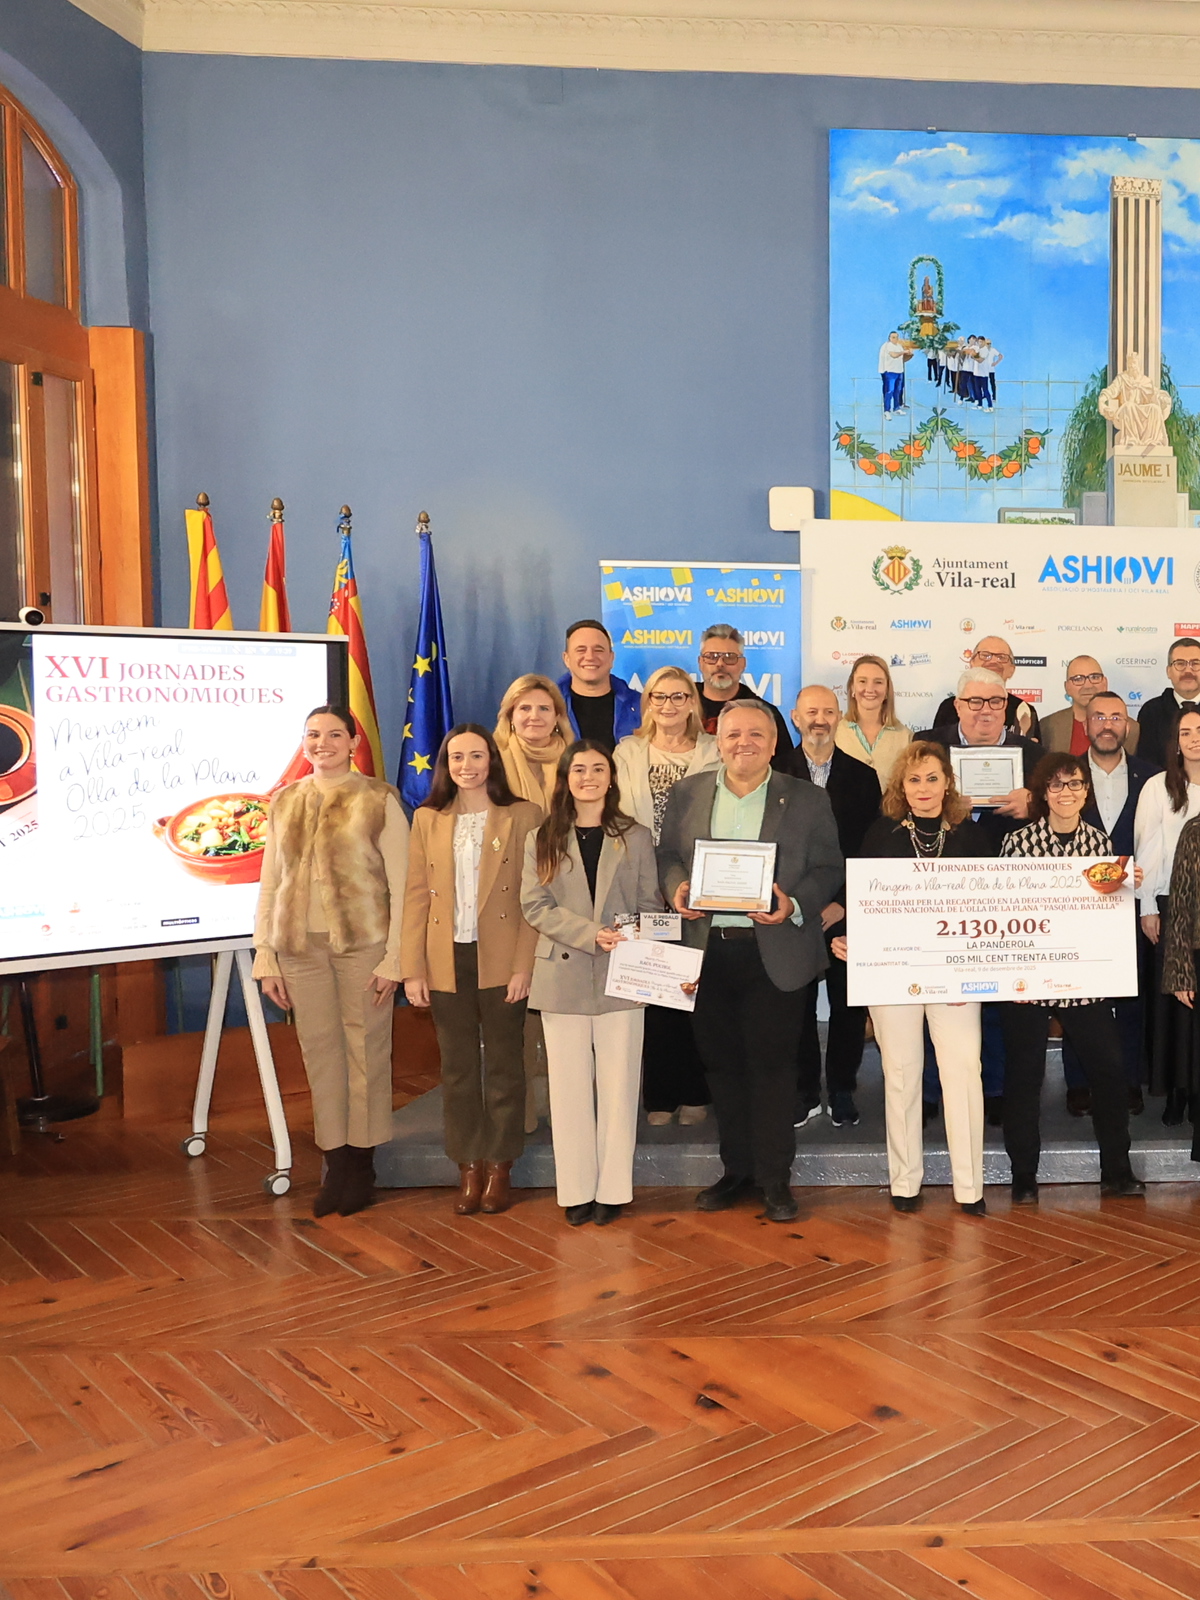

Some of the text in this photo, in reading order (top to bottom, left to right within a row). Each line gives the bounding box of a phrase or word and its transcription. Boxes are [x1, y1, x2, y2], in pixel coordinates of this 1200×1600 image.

[1118, 463, 1171, 478] JAUME I
[932, 558, 1009, 572] Ajuntament
[1037, 554, 1174, 586] ASHIOVI
[924, 571, 1016, 589] de Vila-real
[621, 586, 692, 602] ASHIOVI
[714, 588, 785, 604] ASHIOVI
[890, 619, 931, 629] ASHIOVI
[621, 629, 692, 645] ASHIOVI
[45, 655, 245, 682] XVI JORNADES
[1115, 657, 1158, 665] GESERINFO
[46, 683, 284, 707] GASTRONÒMIQUES
[50, 714, 157, 751] Mengem
[60, 728, 185, 781] a Vila-real
[67, 757, 260, 812] Olla de la Plana
[73, 803, 146, 841] 2025
[9, 819, 39, 842] 2025
[912, 862, 1073, 873] XVI JORNADES GASTRONÒMIQUES
[868, 878, 912, 897] Mengem
[923, 876, 966, 891] Vila-real
[968, 877, 990, 891] Olla
[992, 877, 1004, 890] de
[1005, 876, 1016, 890] la
[1018, 876, 1047, 890] Plana
[1049, 875, 1083, 889] 2025
[876, 899, 915, 907] SOLIDARI
[933, 898, 944, 906] LA
[945, 896, 996, 905] RECAPTACIÓ
[1021, 895, 1071, 904] DEGUSTACIÓ
[1109, 895, 1124, 903] DEL
[903, 906, 946, 914] NACIONAL
[959, 905, 987, 913] L'OLLA
[936, 918, 1051, 940] 2.130,00€
[966, 940, 1035, 950] LA PANDEROLA
[946, 952, 1080, 964] DOS MIL CENT TRENTA EUROS
